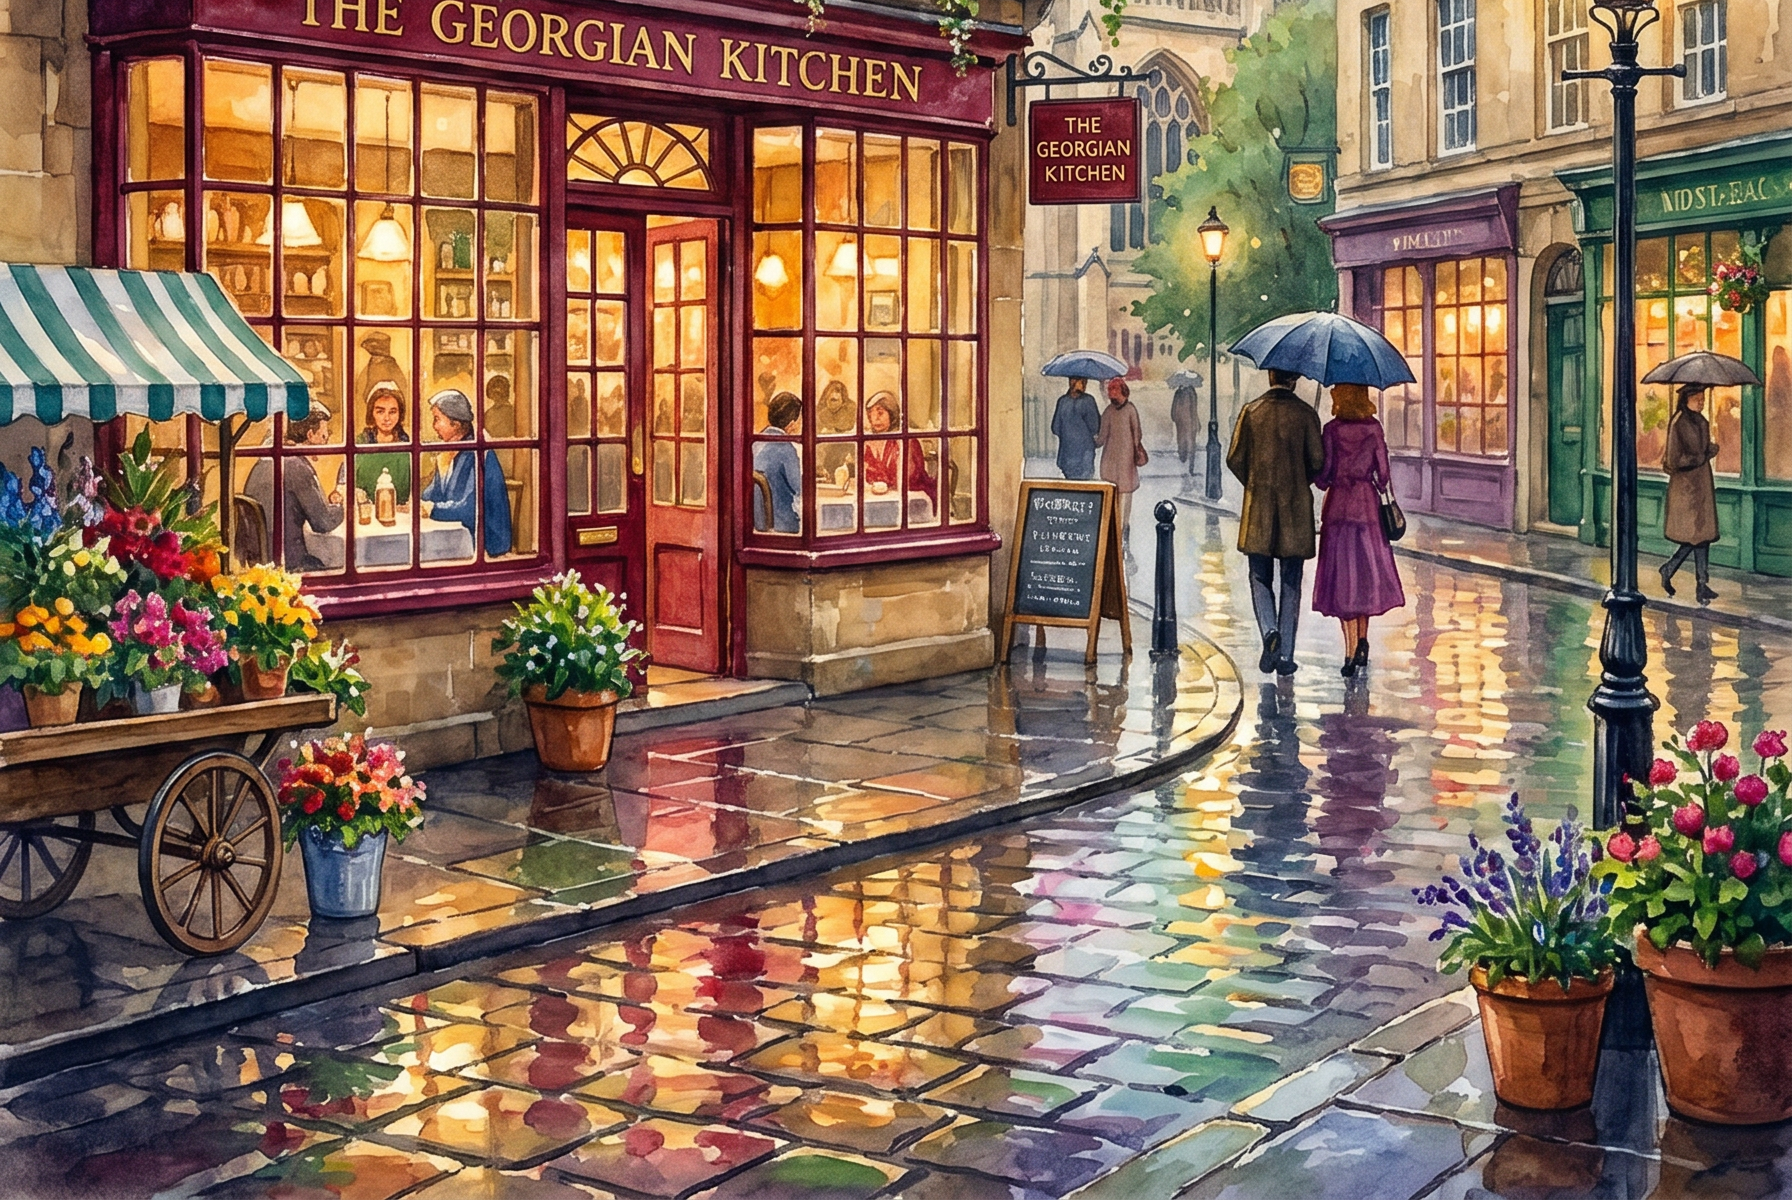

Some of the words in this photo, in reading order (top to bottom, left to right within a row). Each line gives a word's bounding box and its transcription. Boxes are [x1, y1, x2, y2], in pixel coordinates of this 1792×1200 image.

[430, 0, 697, 75] GEORGIAN
[719, 37, 923, 103] KITCHEN
[1064, 116, 1102, 134] THE
[1036, 139, 1131, 158] GEORGIAN
[1045, 164, 1126, 182] KITCHEN
